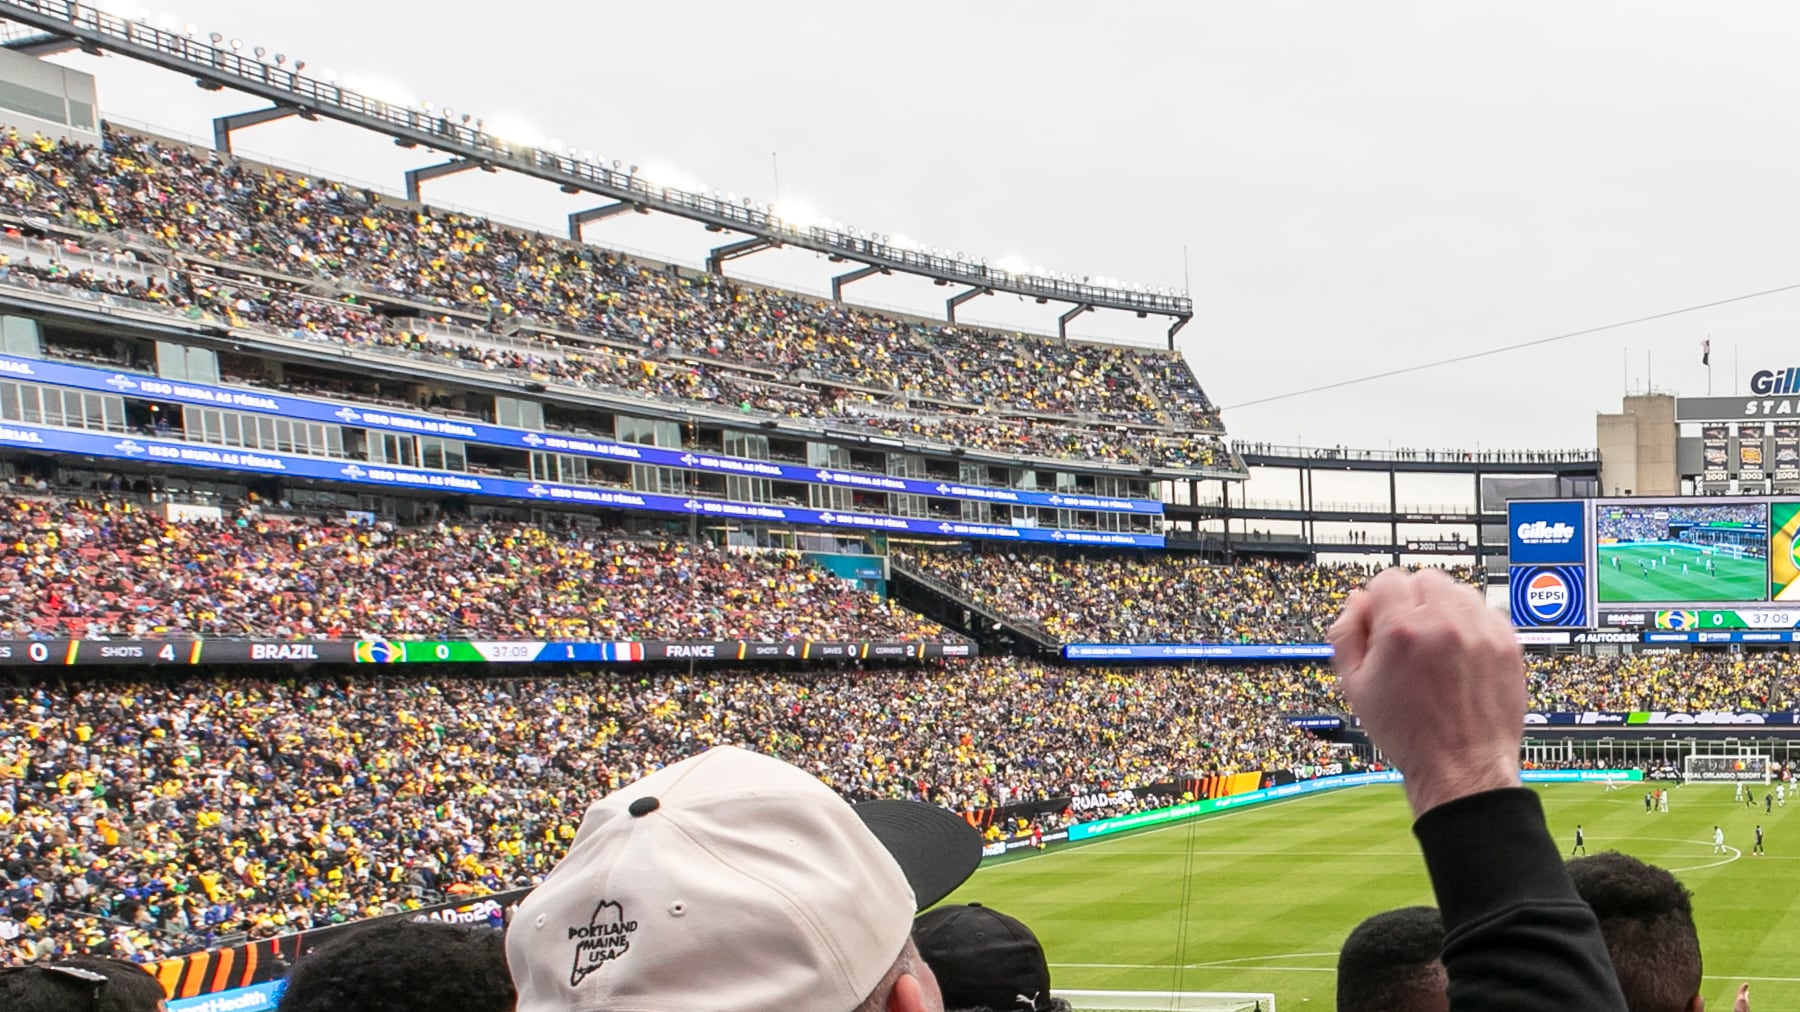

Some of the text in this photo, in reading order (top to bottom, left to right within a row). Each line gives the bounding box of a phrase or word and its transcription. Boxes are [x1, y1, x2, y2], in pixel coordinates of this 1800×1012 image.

[1775, 472, 1799, 480] 2004
[1517, 521, 1575, 540] Gillette
[1530, 591, 1564, 600] PEPSI
[1712, 613, 1722, 625] 0
[1753, 613, 1789, 624] 37:09
[1586, 633, 1639, 642] AUTODESK
[29, 642, 48, 662] 0
[101, 646, 143, 657] SHOTS
[159, 644, 176, 661] 4
[250, 643, 319, 660] BRAZIL
[436, 645, 449, 659] 0
[493, 646, 528, 657] 37:09
[566, 645, 575, 658] 1
[666, 645, 714, 657] FRANCE
[756, 645, 795, 656] SHOTS 4
[848, 645, 856, 656] 0
[907, 645, 915, 656] 2
[569, 921, 637, 939] PORTLAND
[583, 935, 627, 950] MAINE
[589, 949, 616, 962] USA
